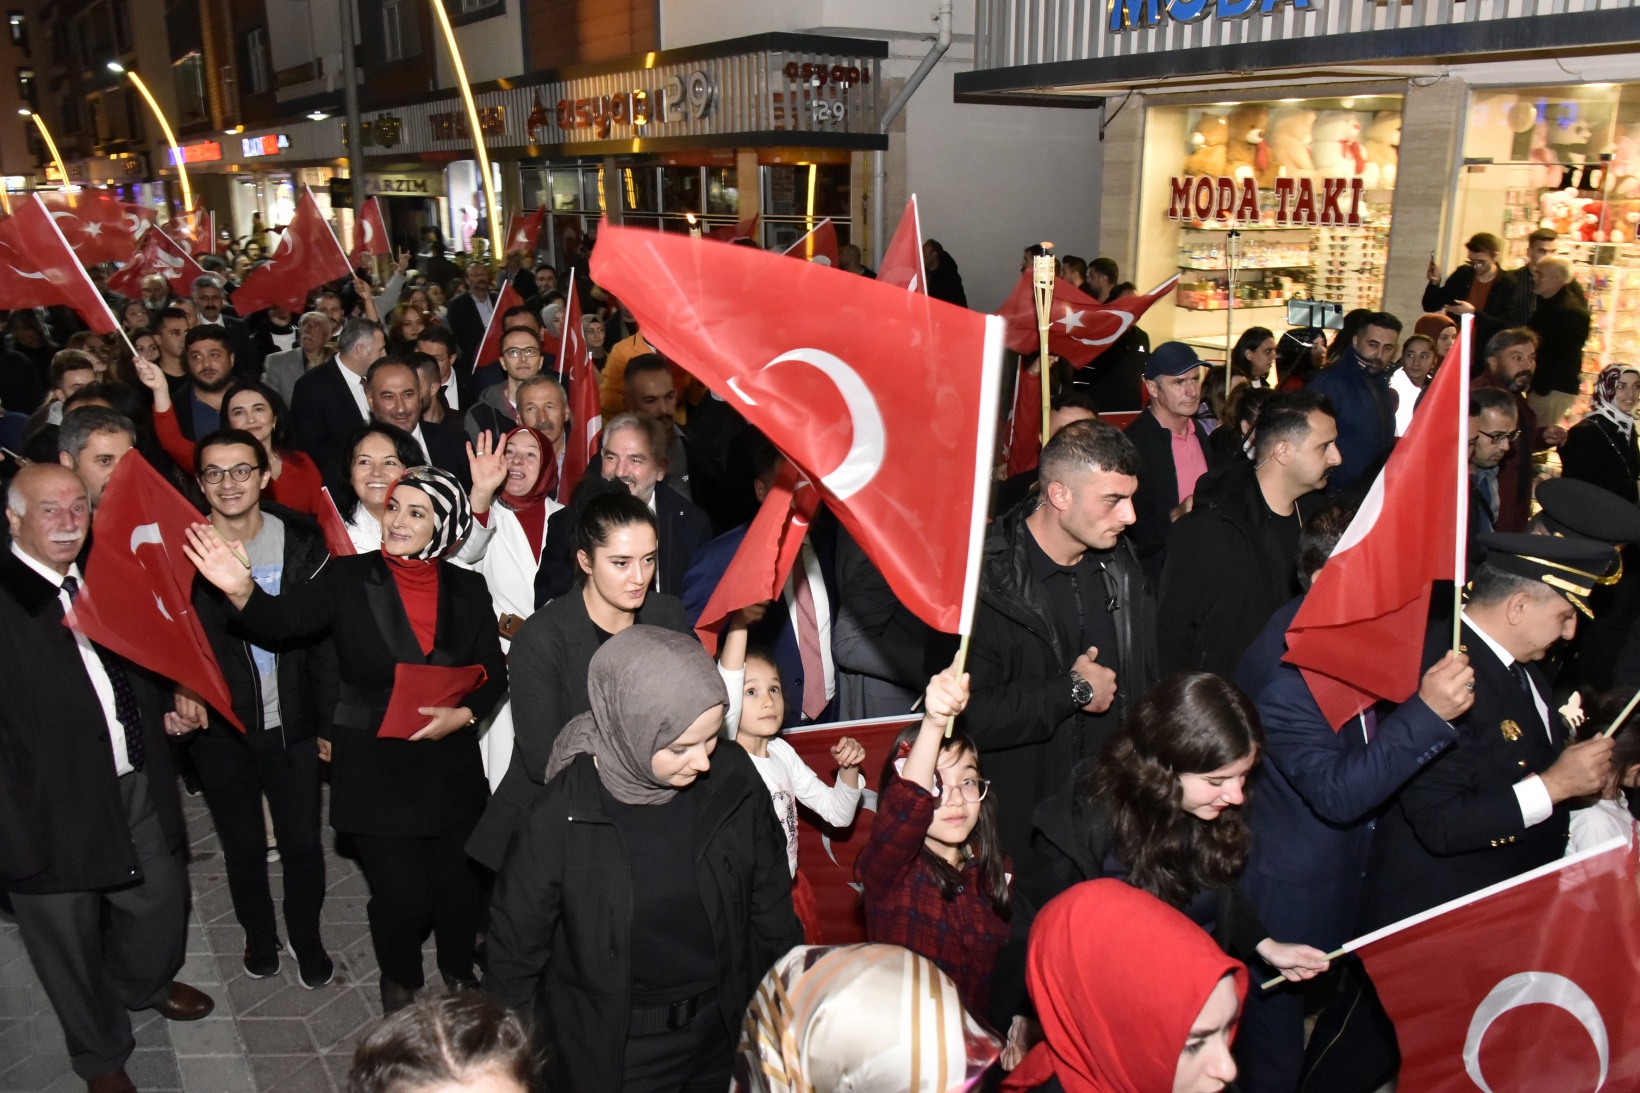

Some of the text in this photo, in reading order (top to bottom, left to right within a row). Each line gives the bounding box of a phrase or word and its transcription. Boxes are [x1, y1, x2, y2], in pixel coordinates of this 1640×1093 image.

[666, 71, 713, 122] 29
[818, 101, 845, 121] 29
[1168, 175, 1365, 227] MODA TAKI
